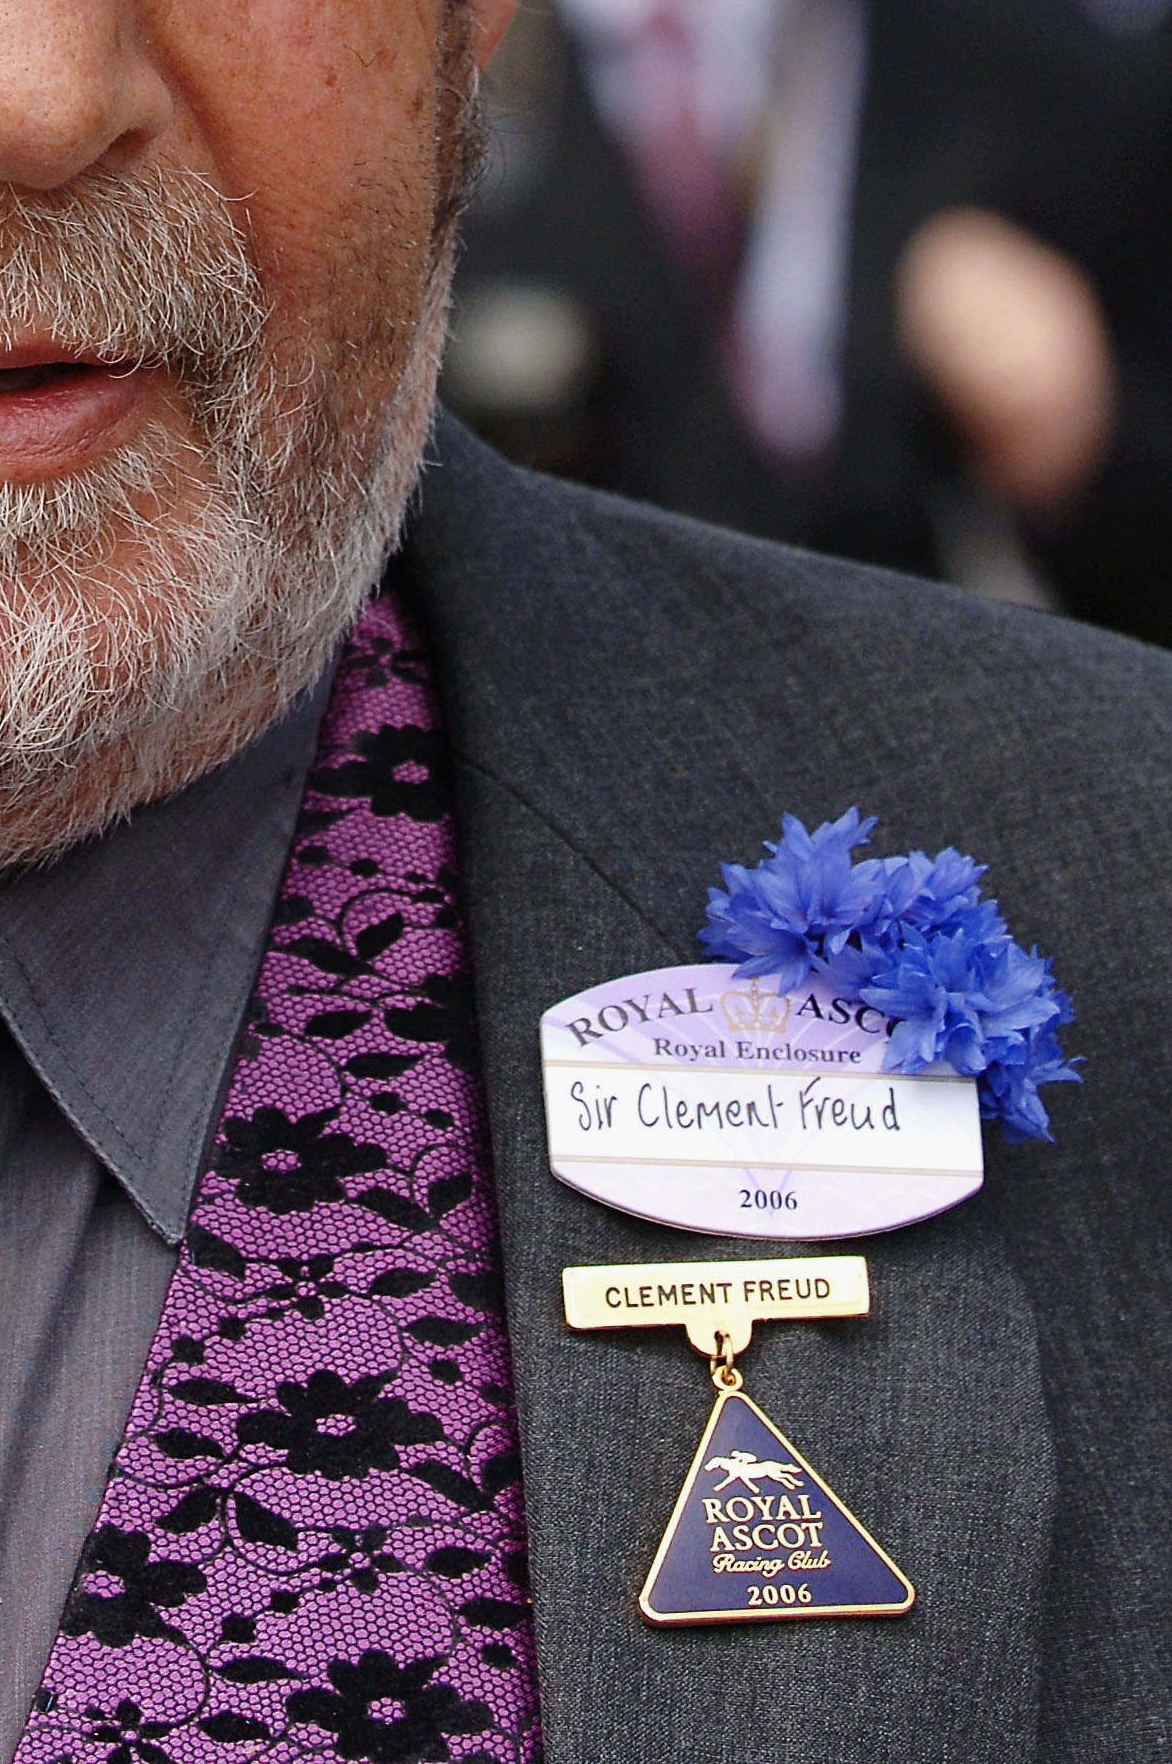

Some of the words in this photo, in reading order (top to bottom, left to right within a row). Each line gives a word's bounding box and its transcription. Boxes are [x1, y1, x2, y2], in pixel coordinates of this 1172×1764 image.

[565, 988, 713, 1048] ROYAL
[653, 1038, 726, 1061] Royal
[737, 1041, 861, 1064] Enclosure
[570, 1081, 618, 1131] Sir
[638, 1083, 783, 1130] Clement
[798, 1076, 900, 1131] Freud
[739, 1189, 798, 1210] 2006
[605, 1283, 732, 1308] CLEMENT
[744, 1278, 830, 1302] FREUD
[702, 1494, 821, 1523] ROYAL
[710, 1522, 823, 1552] ASCOT
[712, 1554, 784, 1577] Racing
[787, 1550, 830, 1571] Club
[747, 1584, 811, 1606] 2006
